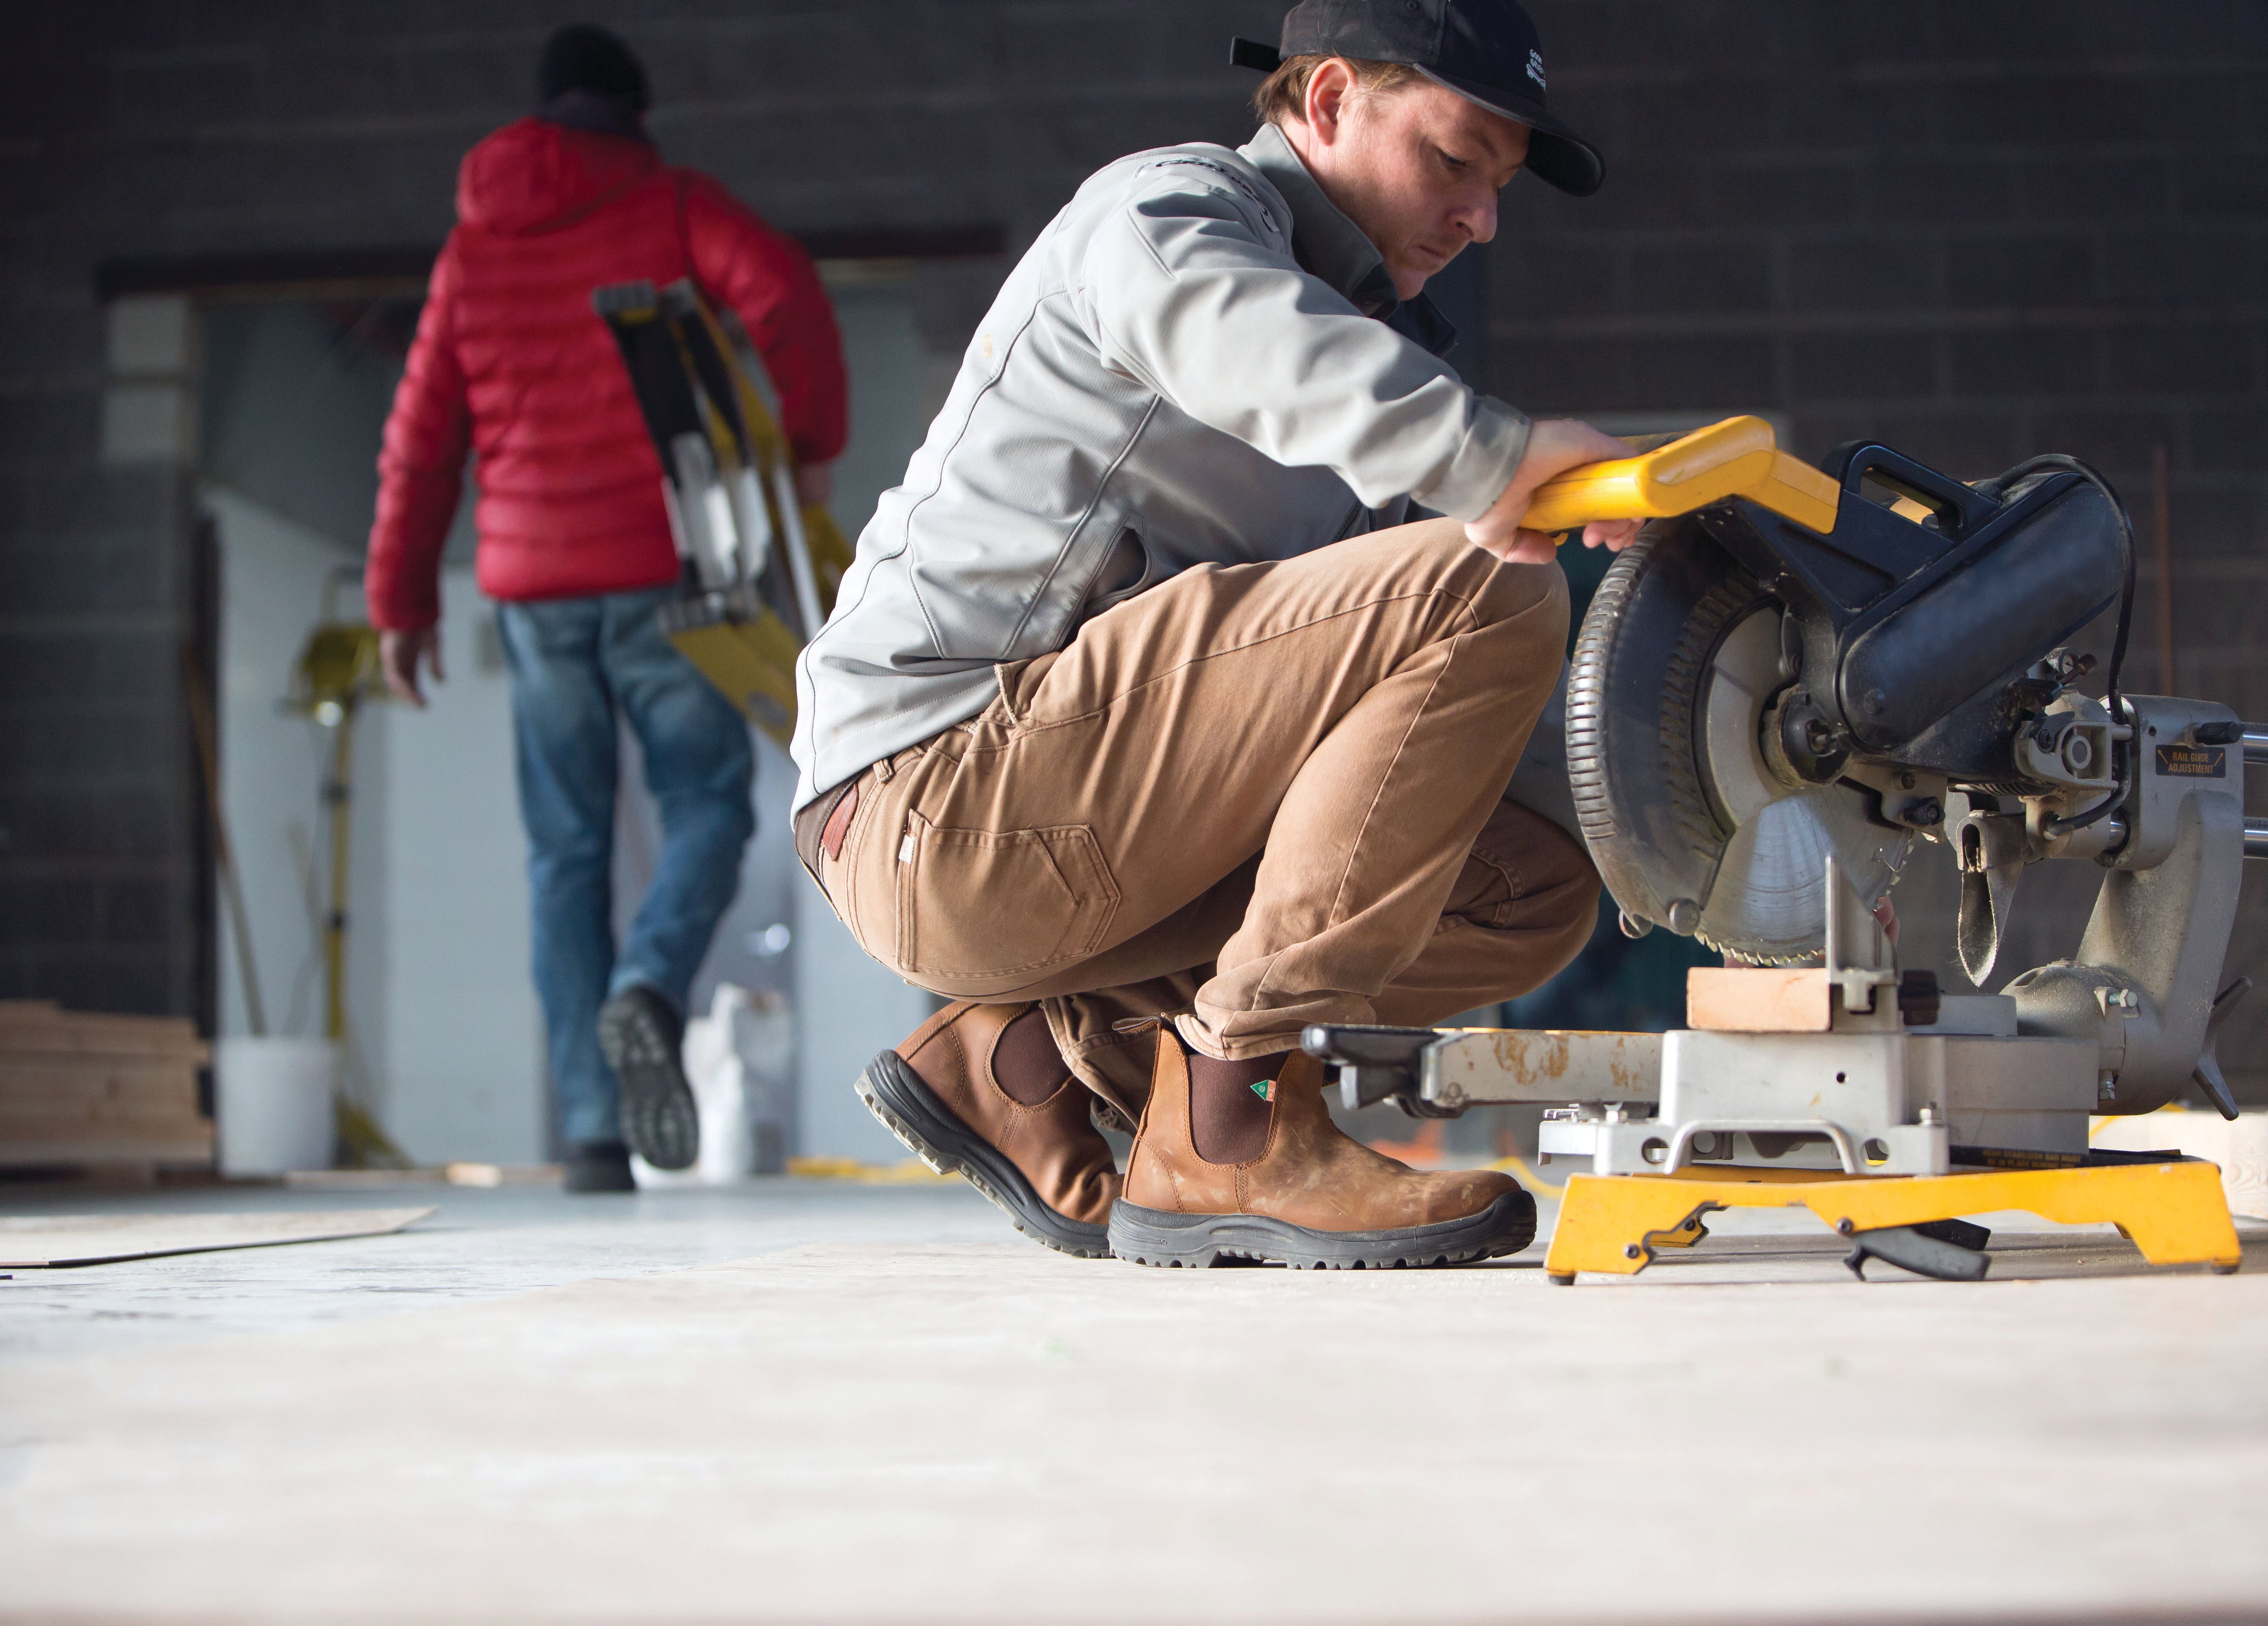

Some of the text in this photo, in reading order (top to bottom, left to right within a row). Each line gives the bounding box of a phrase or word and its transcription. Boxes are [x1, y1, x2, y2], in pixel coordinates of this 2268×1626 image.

[2173, 752, 2209, 762] RAIL GUIDE
[2168, 764, 2213, 773] ADJUSTMENT
